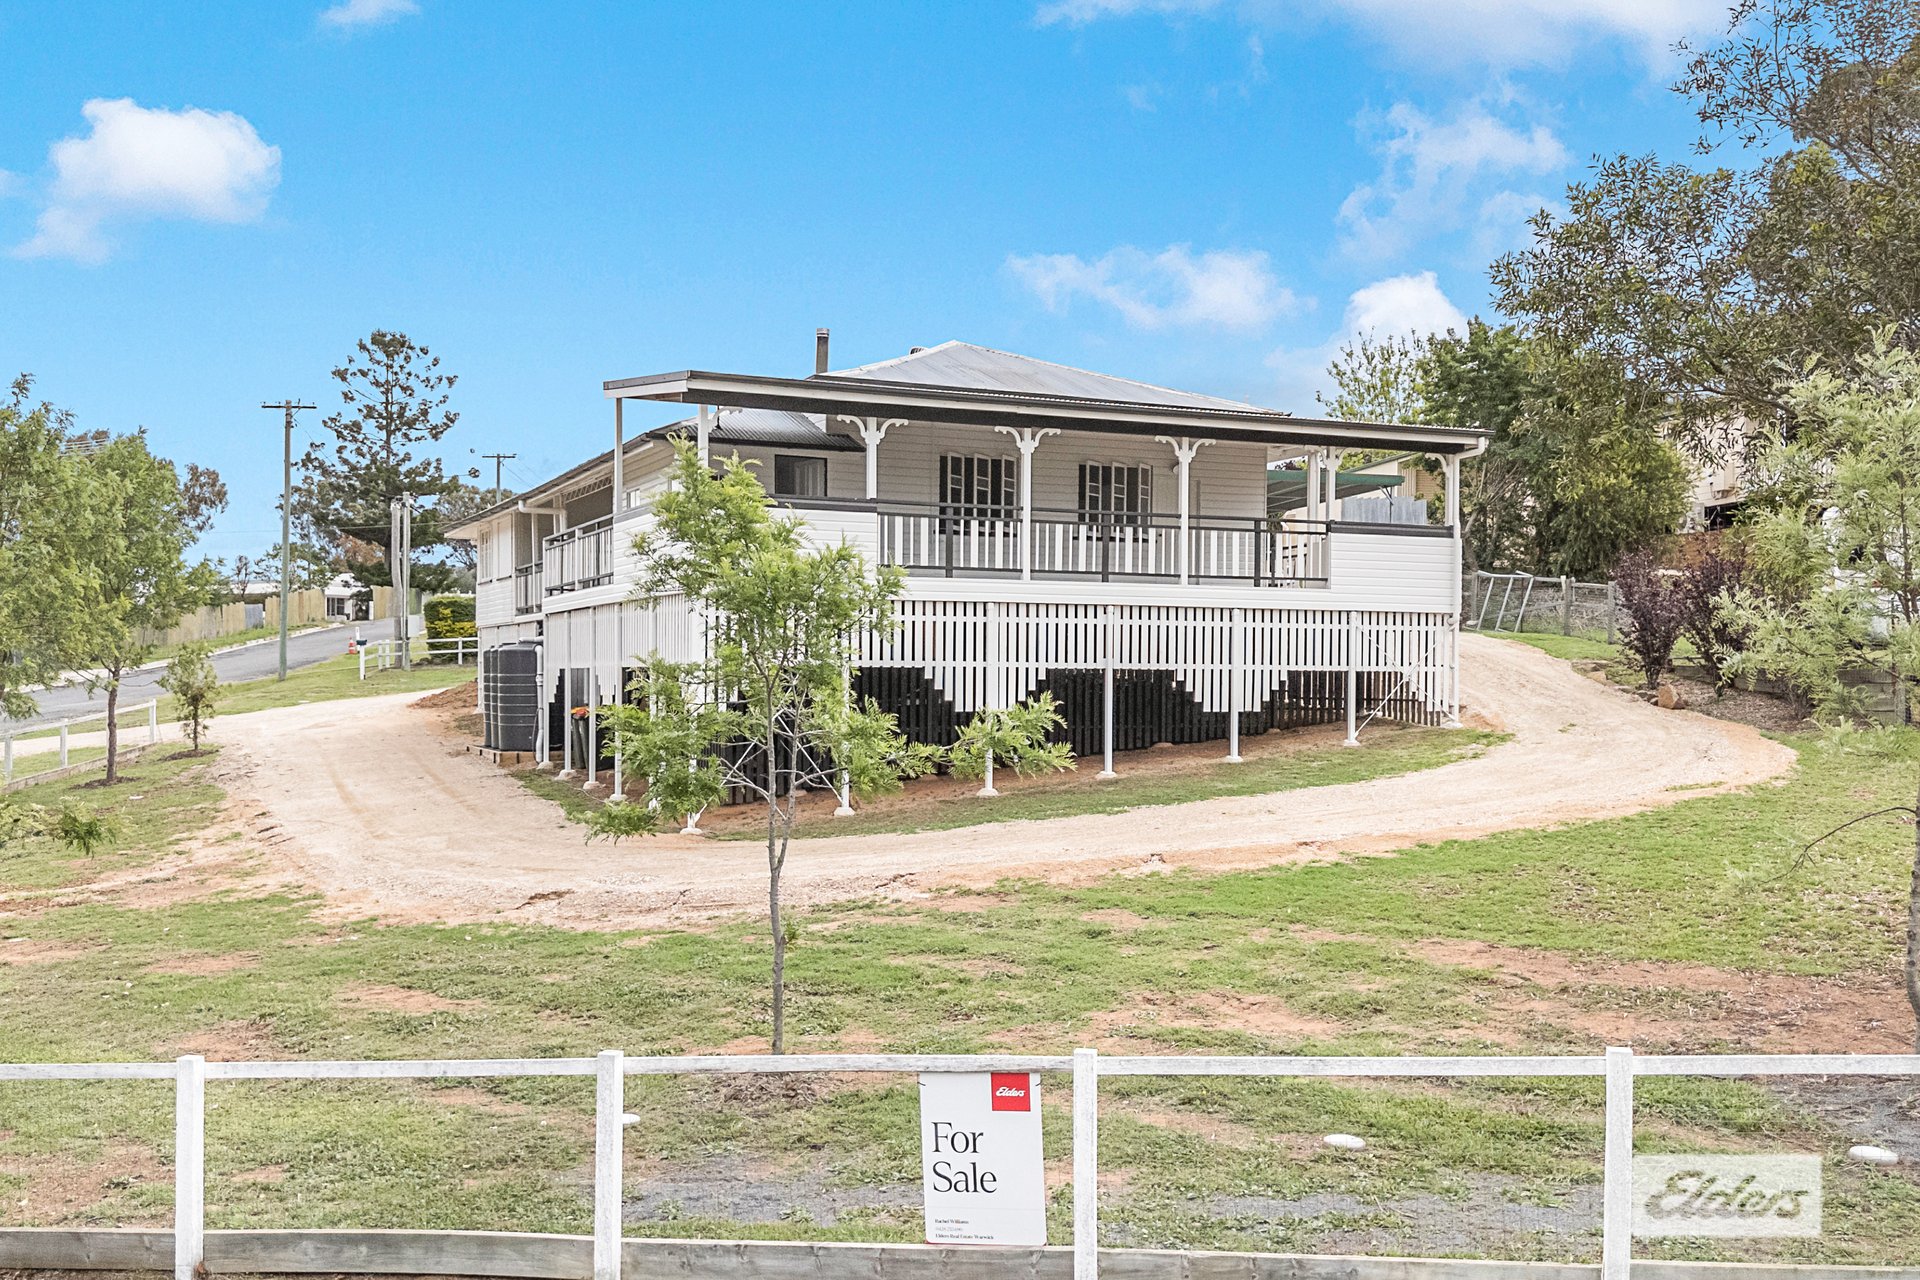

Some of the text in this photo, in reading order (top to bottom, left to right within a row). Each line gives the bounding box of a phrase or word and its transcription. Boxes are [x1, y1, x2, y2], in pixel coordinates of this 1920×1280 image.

[996, 1086, 1026, 1097] Elders
[931, 1121, 984, 1154] For
[932, 1161, 997, 1194] Sale
